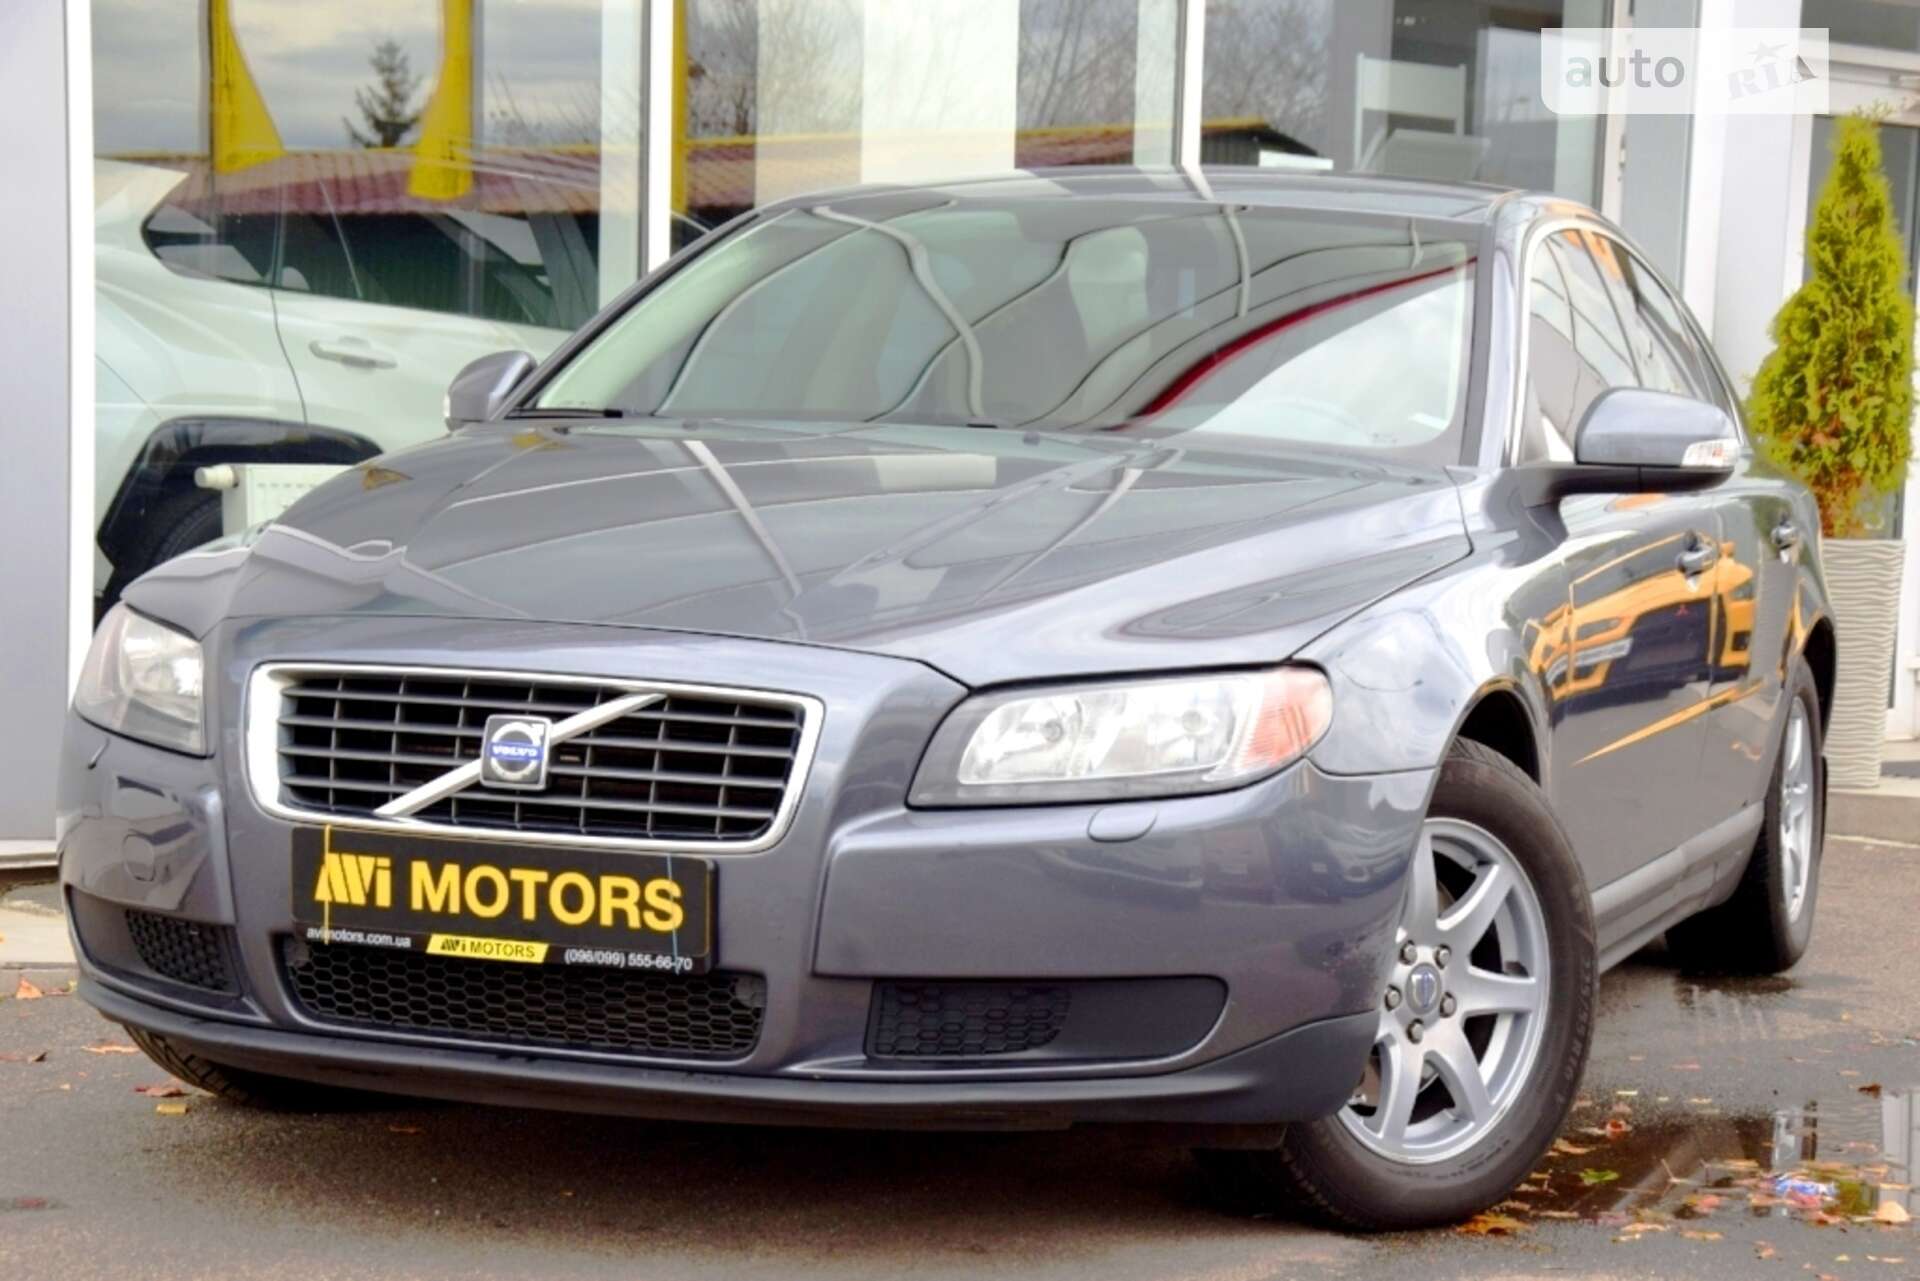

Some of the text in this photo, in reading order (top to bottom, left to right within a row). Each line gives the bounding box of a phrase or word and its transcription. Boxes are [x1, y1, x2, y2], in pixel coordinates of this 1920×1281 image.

[492, 745, 538, 757] VOLVO
[411, 860, 684, 931] MOTORS
[470, 941, 535, 958] MOTORS
[564, 948, 693, 972] (096/099) 555-66-70
